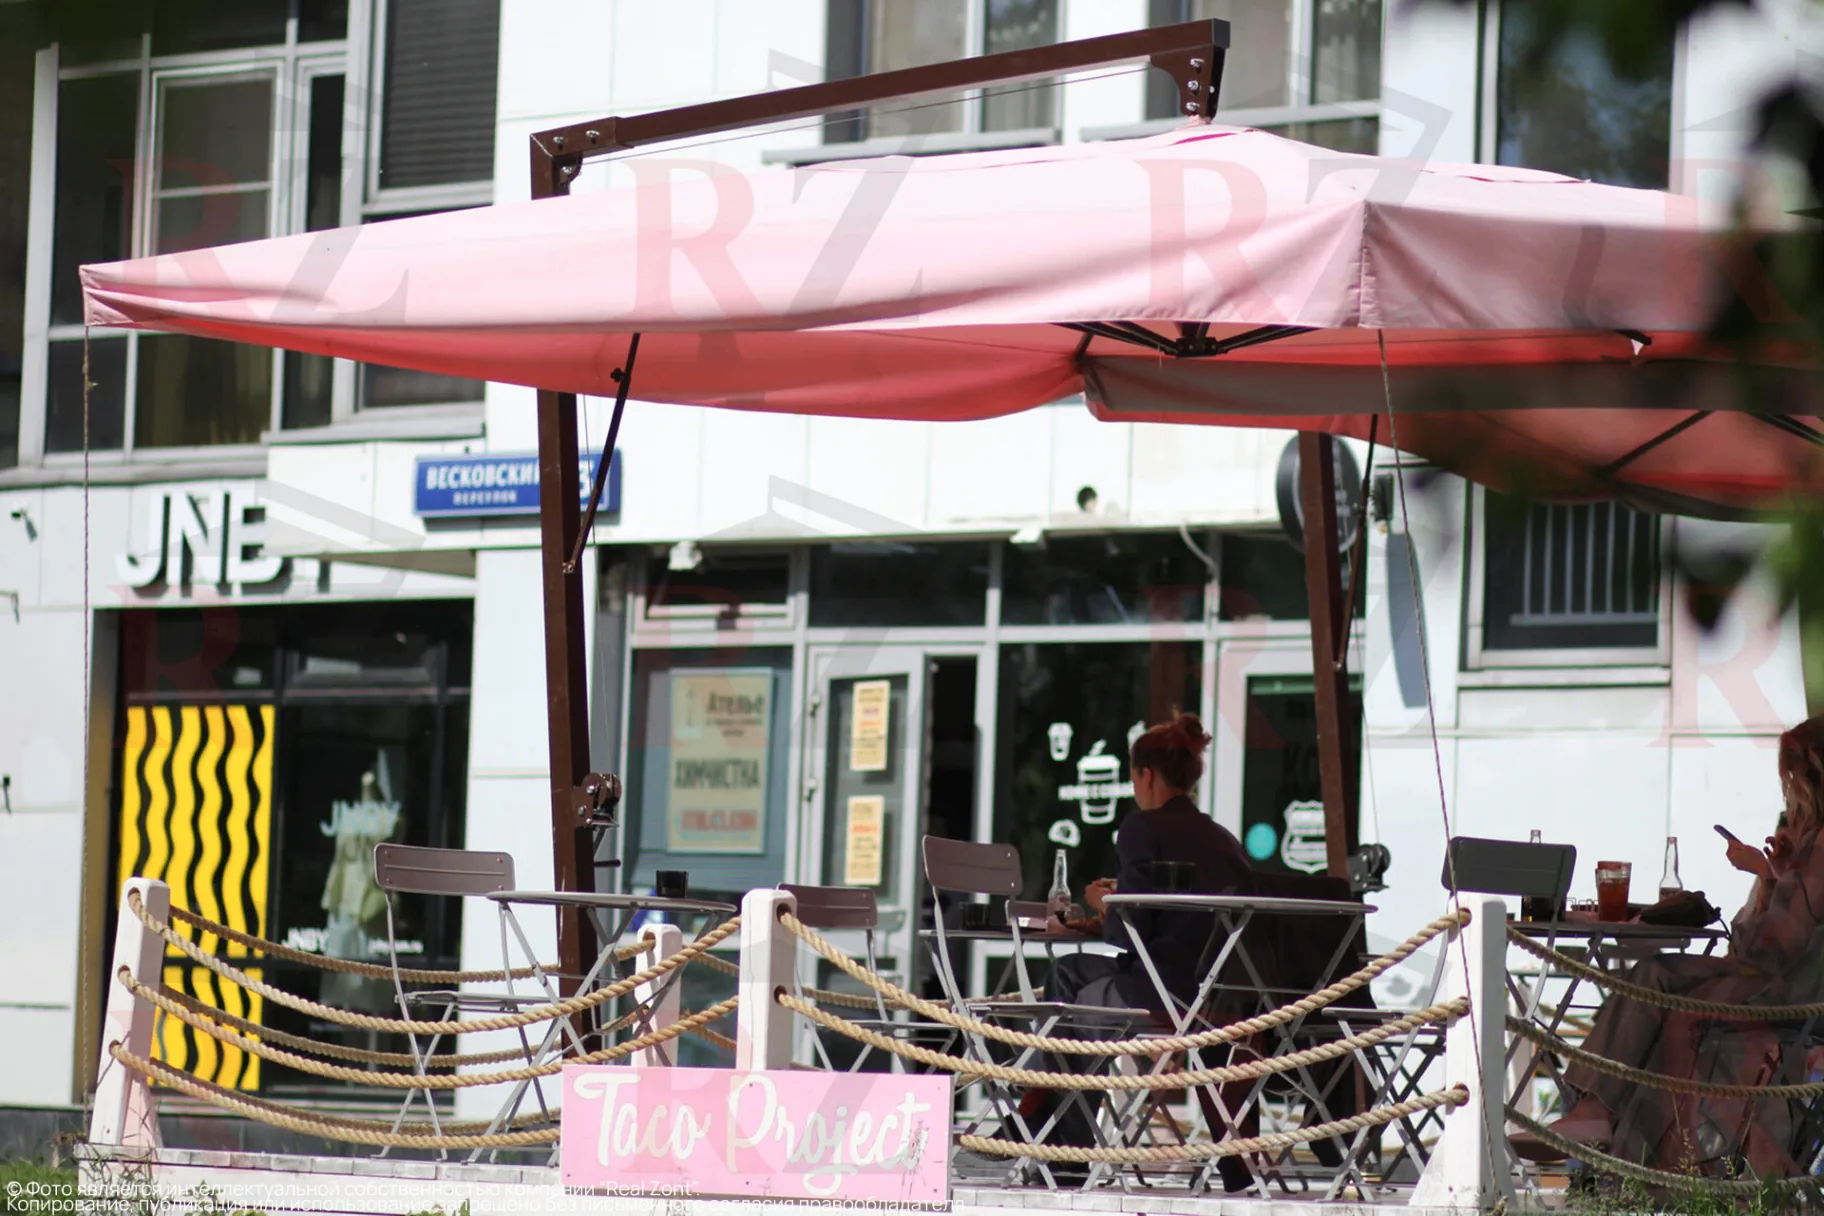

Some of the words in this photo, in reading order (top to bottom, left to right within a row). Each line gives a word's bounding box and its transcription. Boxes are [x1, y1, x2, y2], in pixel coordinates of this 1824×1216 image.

[113, 488, 331, 598] JNB
[706, 692, 765, 715] Ателье
[675, 758, 760, 789] ХИМЧИСТКА
[573, 1072, 712, 1167] Taco
[725, 1074, 932, 1196] Project
